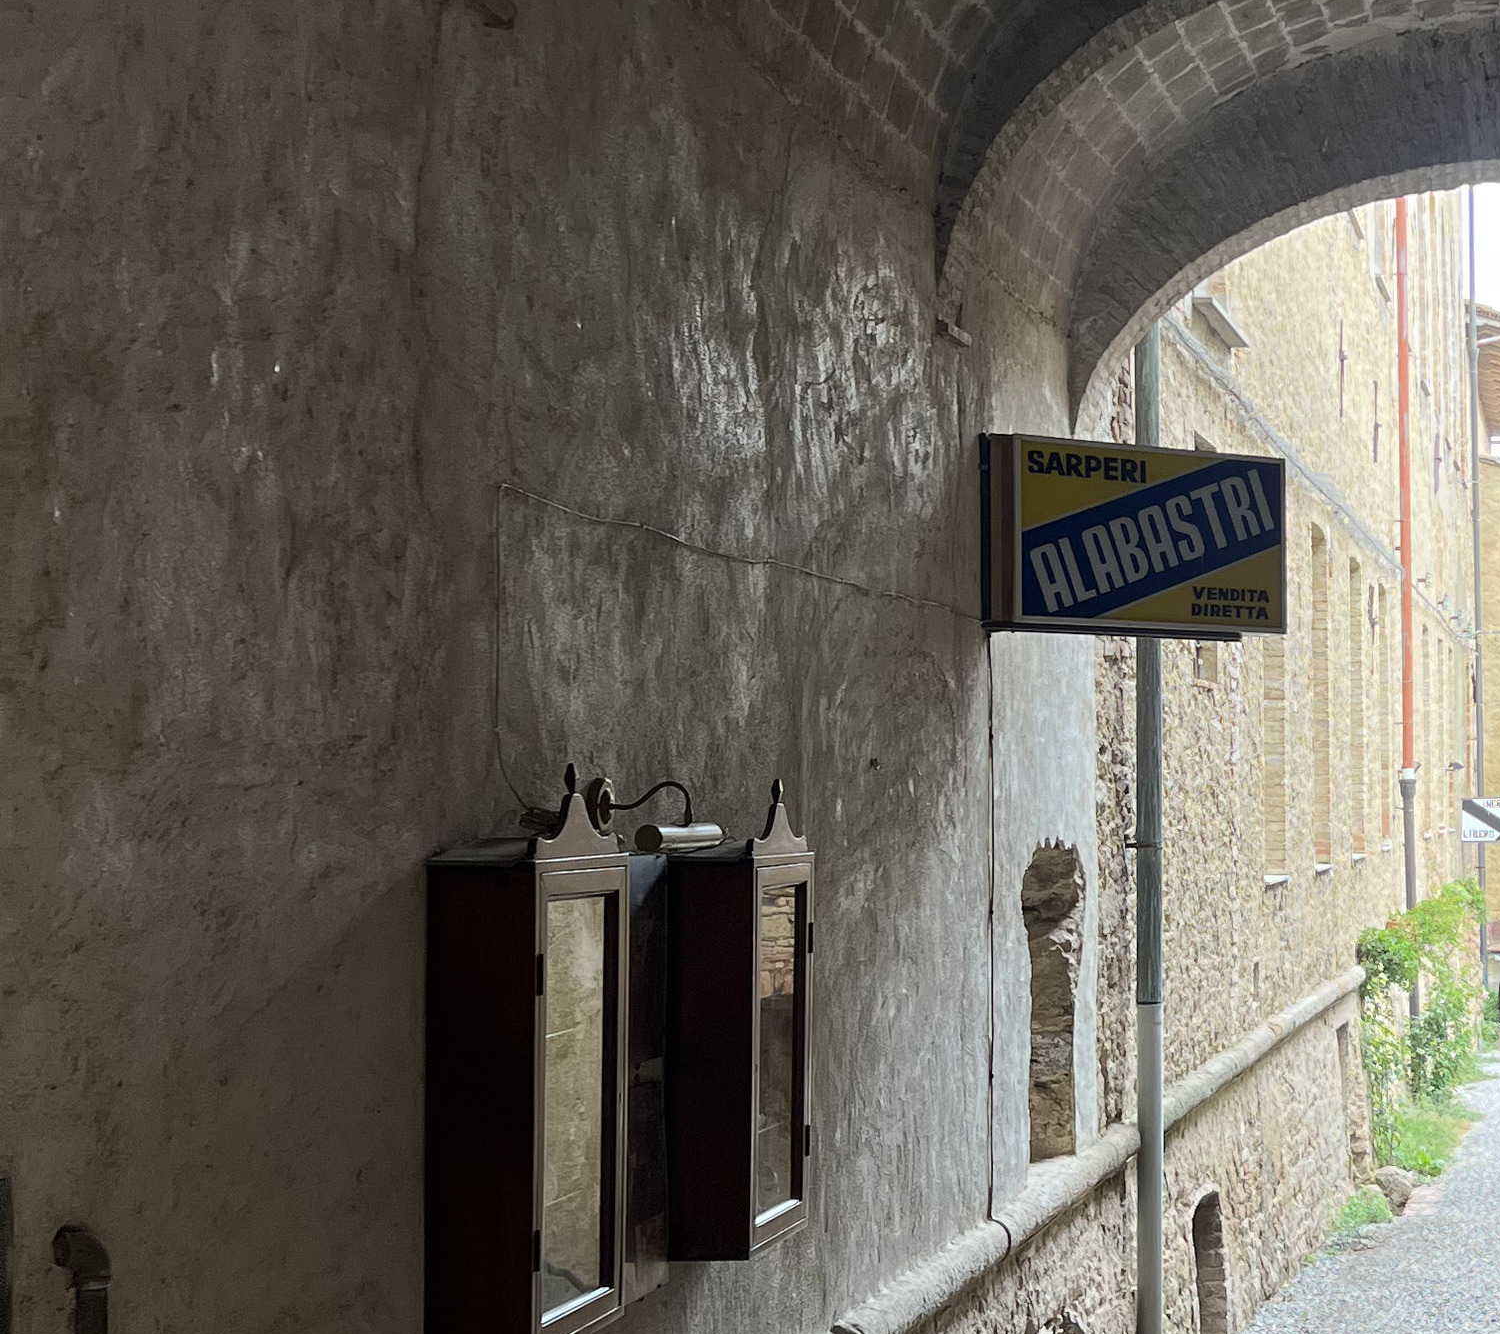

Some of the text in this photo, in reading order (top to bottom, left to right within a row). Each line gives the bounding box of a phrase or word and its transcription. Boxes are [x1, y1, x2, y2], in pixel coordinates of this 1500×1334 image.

[1027, 450, 1147, 484] SARPERI
[1029, 468, 1276, 614] ALABASTRI
[1192, 586, 1270, 604] VENDITA
[1191, 603, 1269, 620] DIRETTA
[1463, 829, 1495, 839] LIBERO
